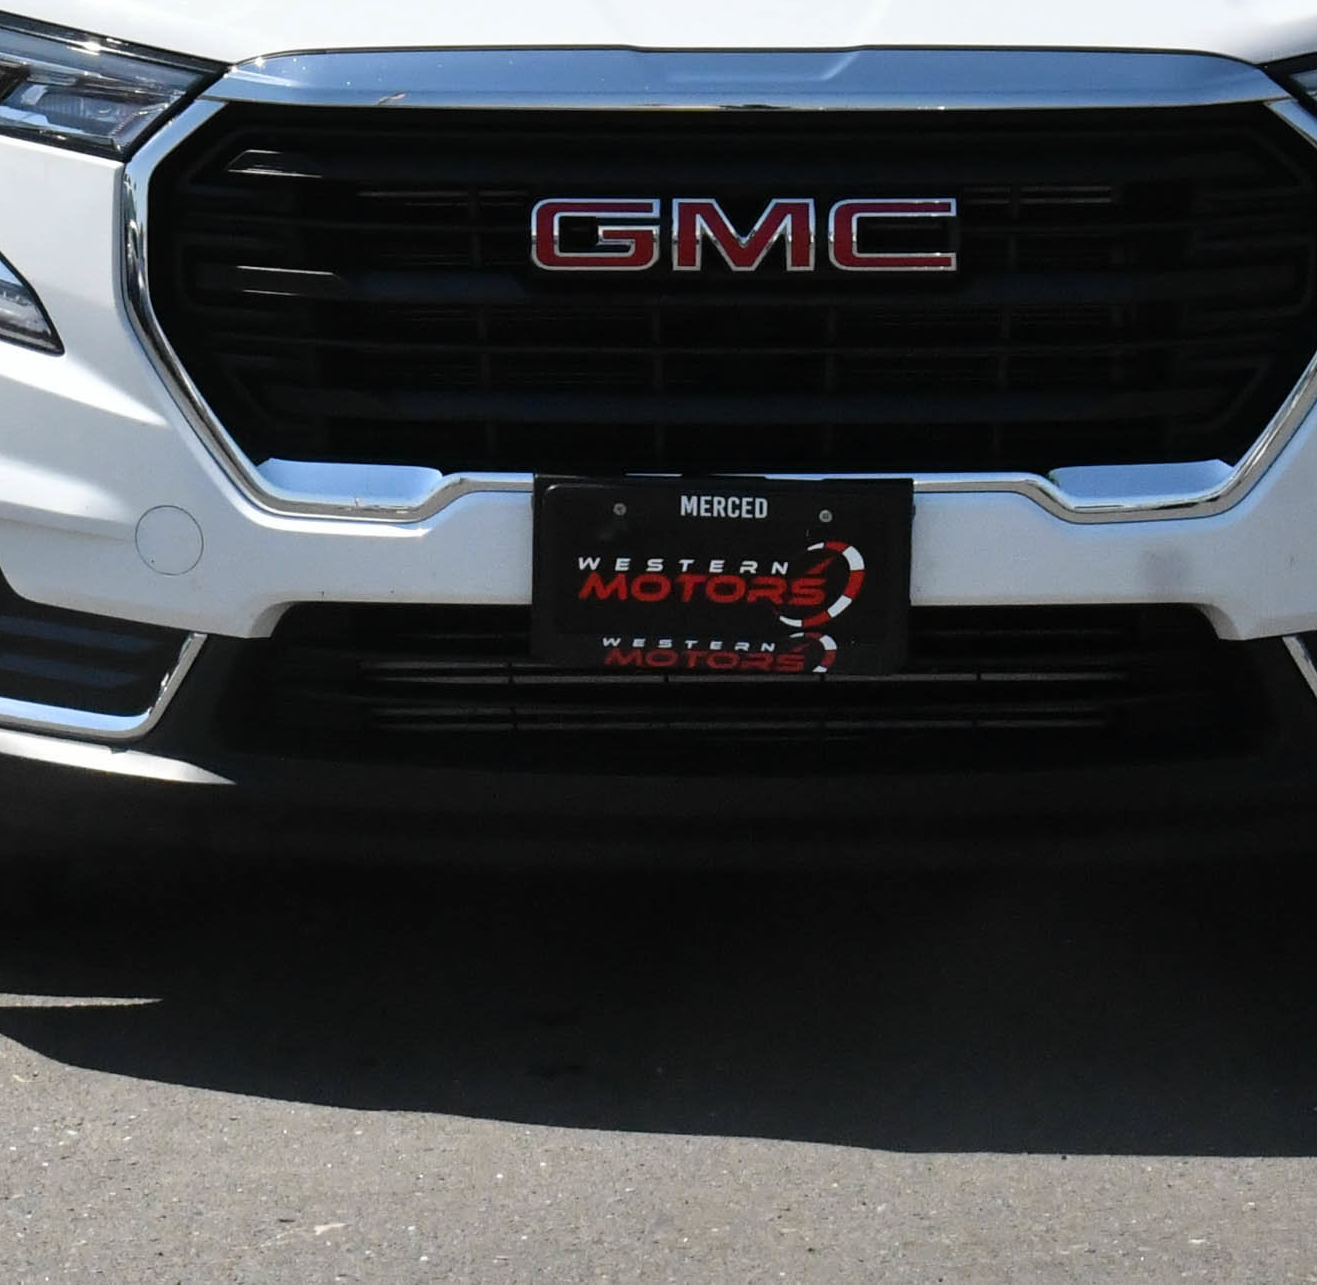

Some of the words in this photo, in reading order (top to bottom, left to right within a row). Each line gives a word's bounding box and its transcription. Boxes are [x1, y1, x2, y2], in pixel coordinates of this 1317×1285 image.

[530, 198, 957, 272] GMC
[680, 495, 769, 519] MERCED
[578, 556, 789, 575] WESTERN
[578, 571, 827, 606] MOTORS
[602, 637, 776, 652] WESTERN
[604, 647, 806, 672] MOTORS
